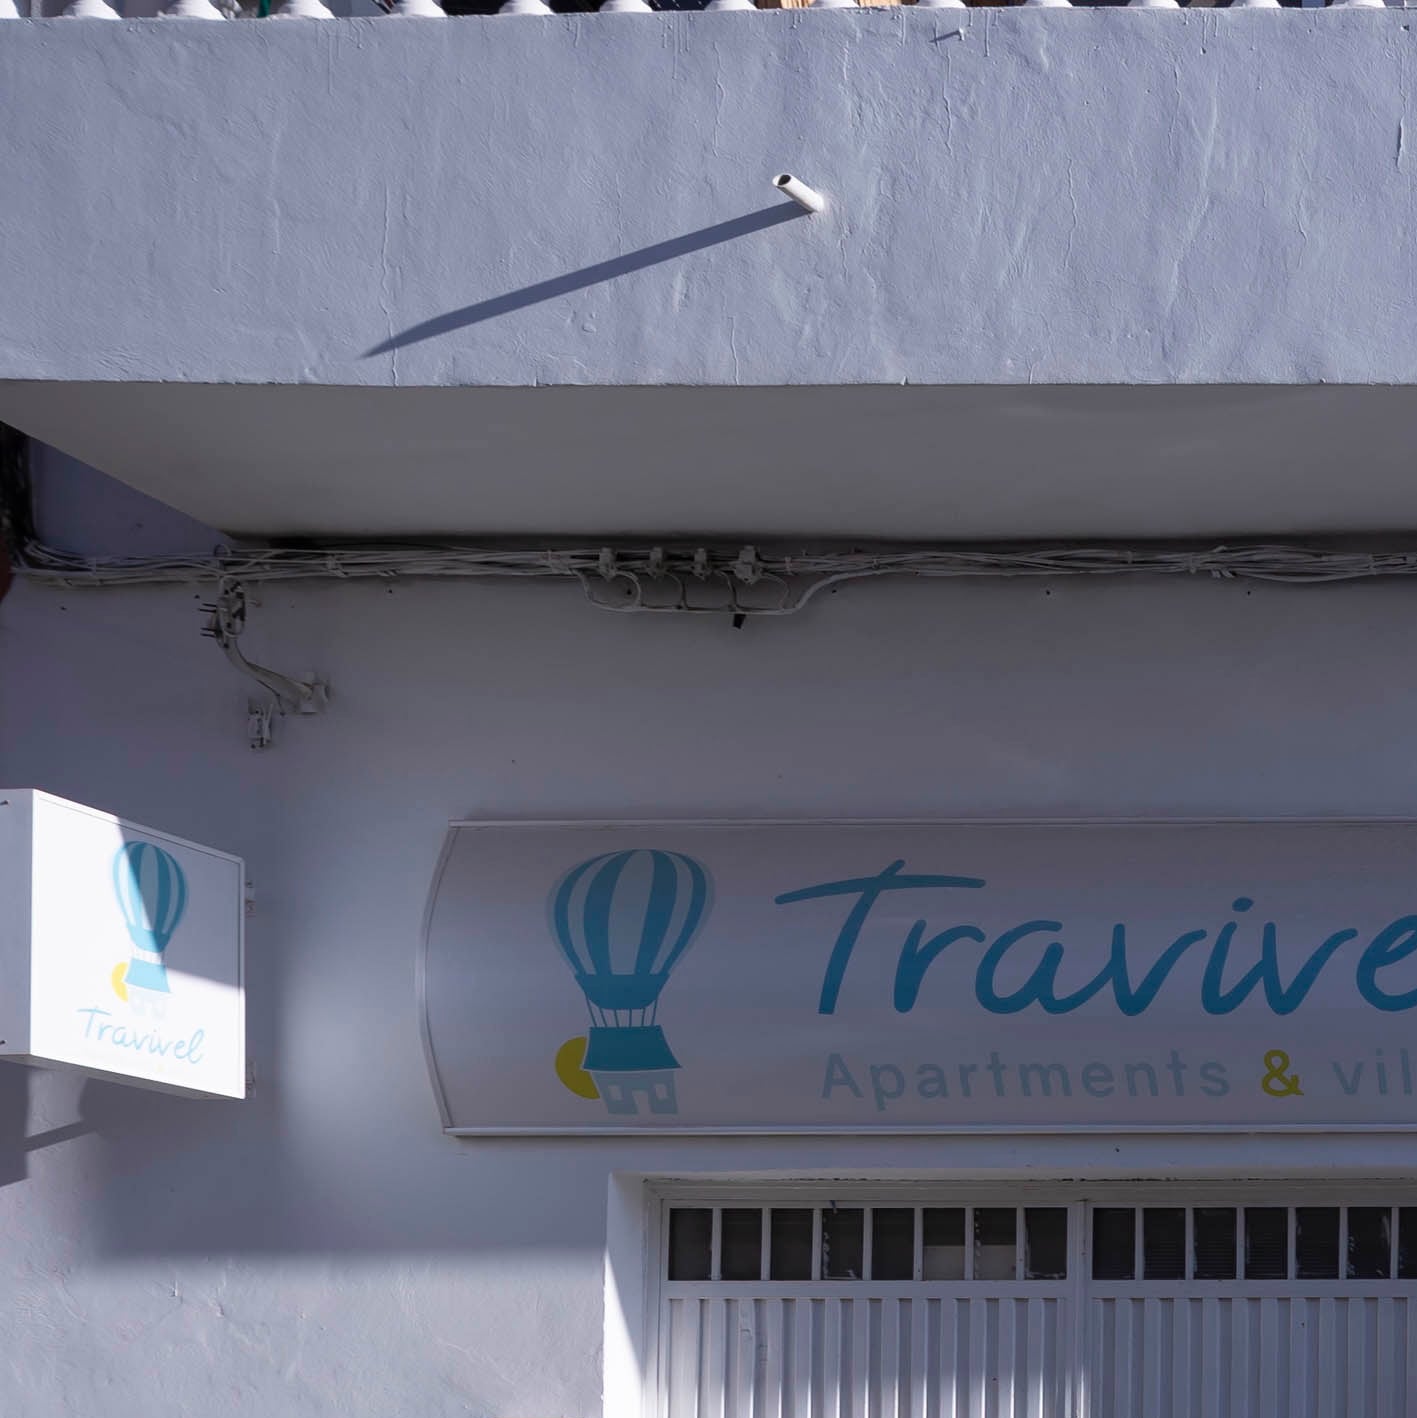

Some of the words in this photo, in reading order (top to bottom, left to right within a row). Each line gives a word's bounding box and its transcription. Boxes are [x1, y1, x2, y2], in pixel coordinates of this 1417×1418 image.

[76, 1004, 206, 1065] Travivel
[820, 1047, 1232, 1112] Apartments
[1260, 1048, 1304, 1098] &
